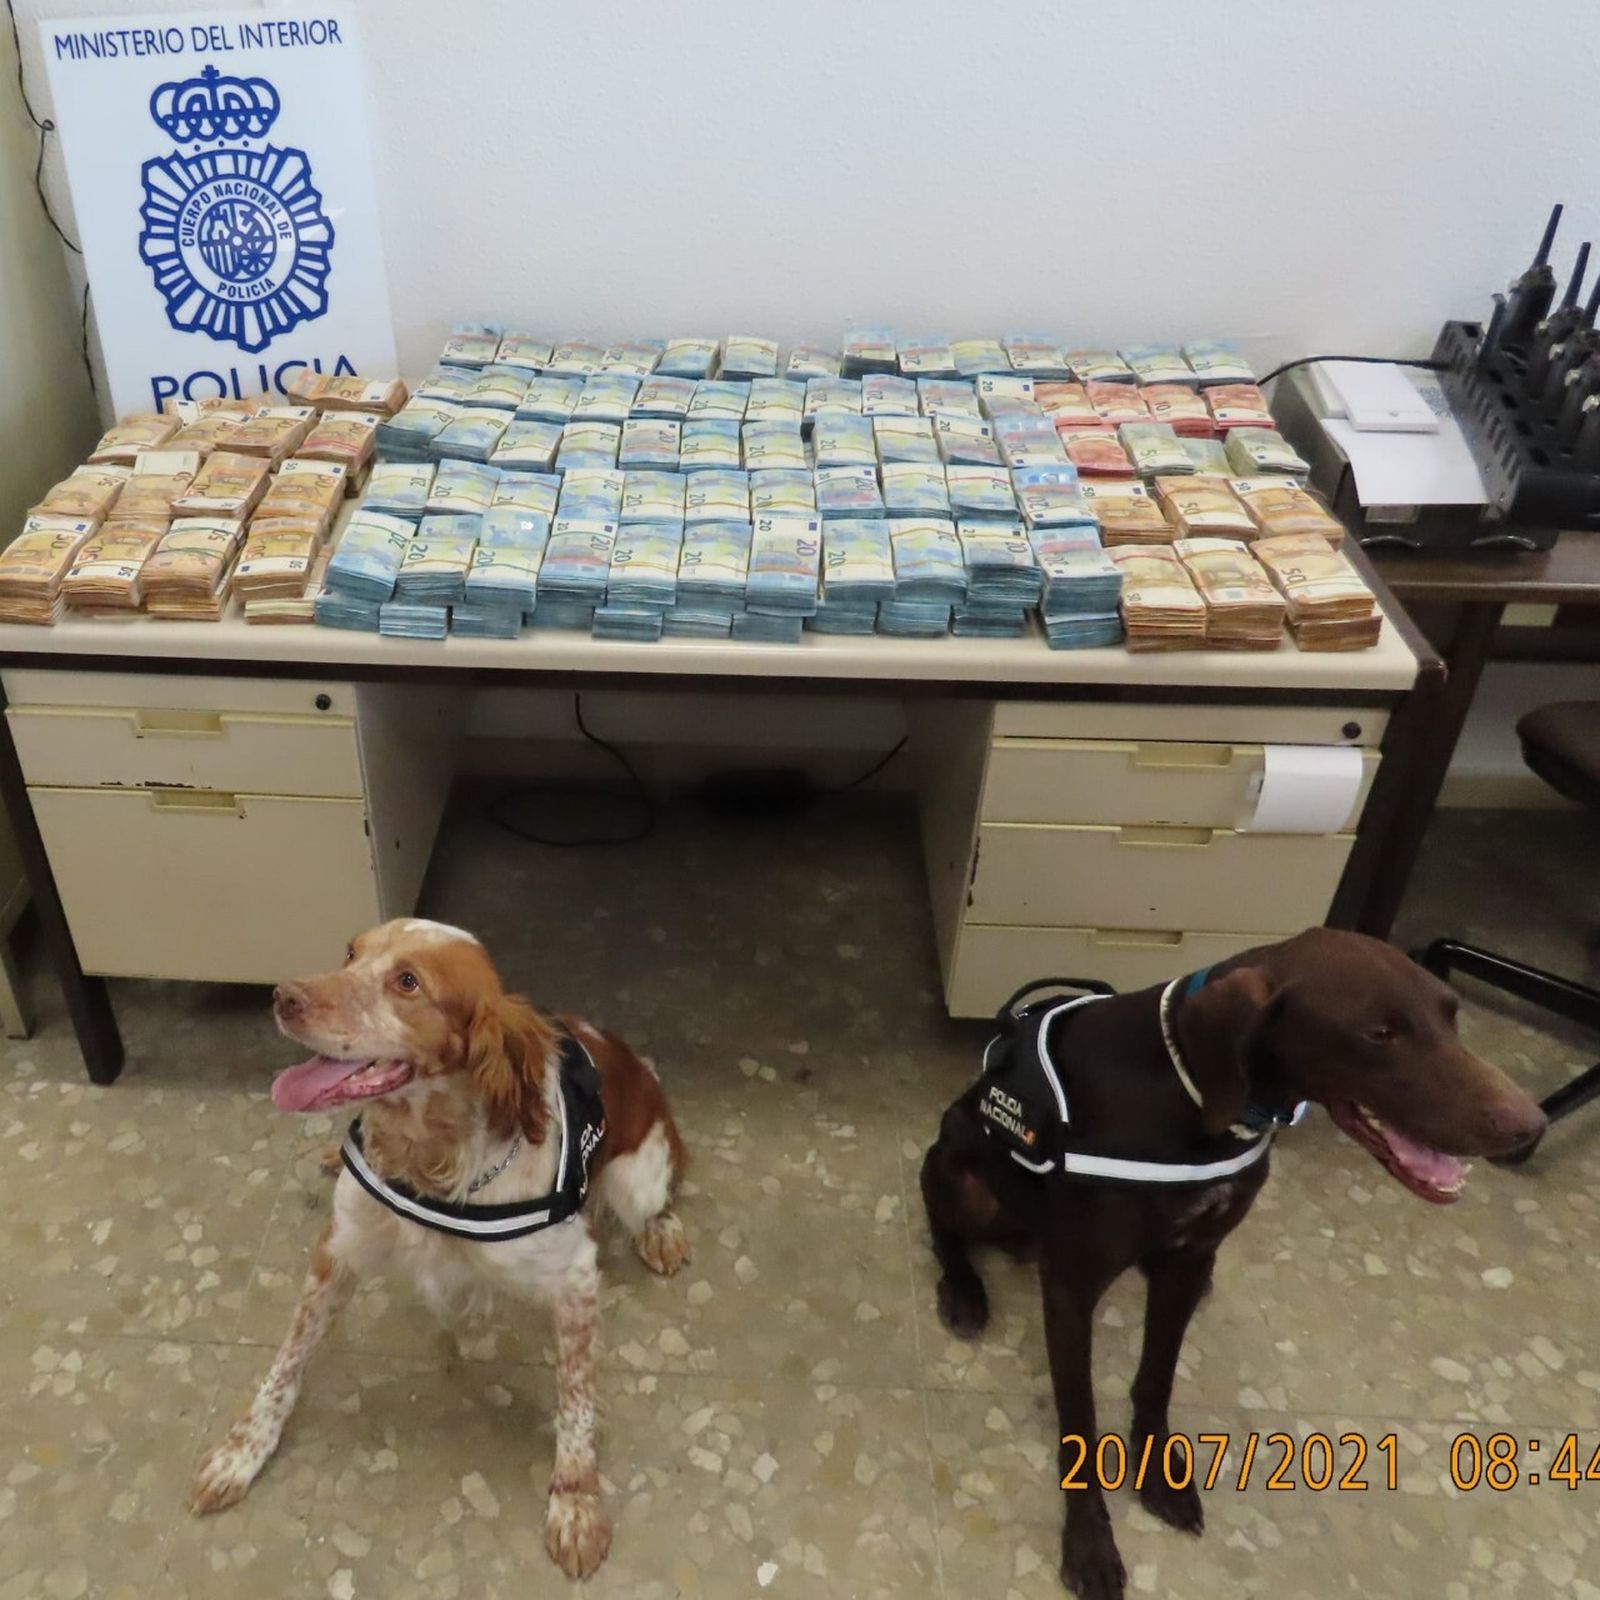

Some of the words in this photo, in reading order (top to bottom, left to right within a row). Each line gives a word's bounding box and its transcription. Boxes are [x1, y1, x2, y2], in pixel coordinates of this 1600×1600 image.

[54, 27, 185, 60] MINISTERIO
[191, 25, 234, 52] DEL
[239, 19, 342, 49] INTERIOR
[181, 191, 212, 247] CUERPO
[213, 182, 281, 219] NACIONAL
[276, 221, 292, 240] DE
[216, 277, 276, 299] POLICIA
[982, 380, 993, 392] 20
[689, 493, 706, 506] 20
[759, 519, 772, 532] 20
[387, 532, 408, 549] 20
[590, 535, 611, 552] 20
[796, 538, 817, 557] 20
[407, 544, 428, 561] 20
[476, 550, 496, 565] 20
[614, 549, 633, 563] 20
[684, 551, 702, 565] 20
[828, 550, 847, 566] 20
[1280, 567, 1308, 584] 50
